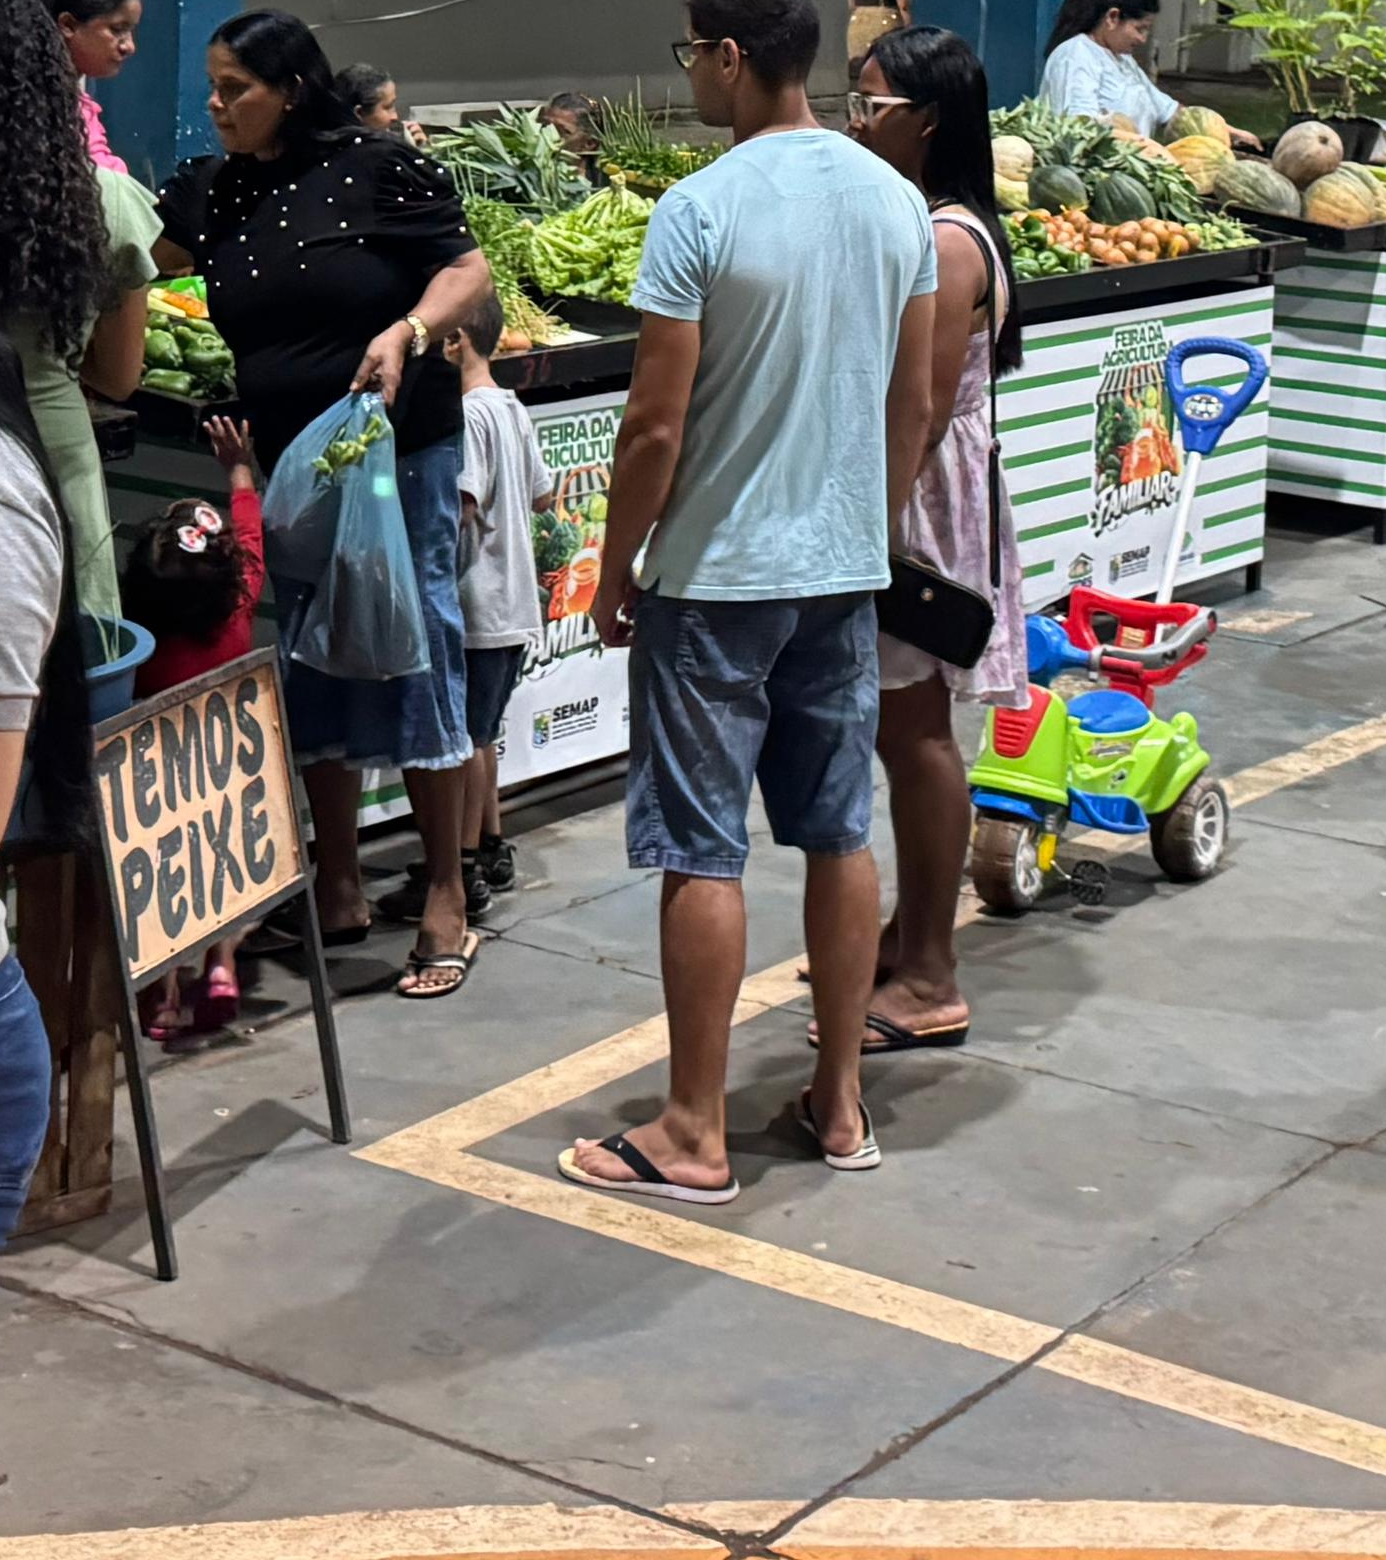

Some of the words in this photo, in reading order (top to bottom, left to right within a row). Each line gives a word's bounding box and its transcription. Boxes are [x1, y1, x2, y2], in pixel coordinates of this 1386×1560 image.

[1115, 327, 1147, 348] FEIRA
[1149, 325, 1163, 342] DA
[538, 420, 588, 448] FEIRA
[591, 416, 615, 437] DA
[1092, 471, 1176, 537] FAMILIAR
[552, 697, 599, 723] SEMAP
[97, 678, 265, 843] TEMOS
[121, 776, 275, 963] PEIXE
